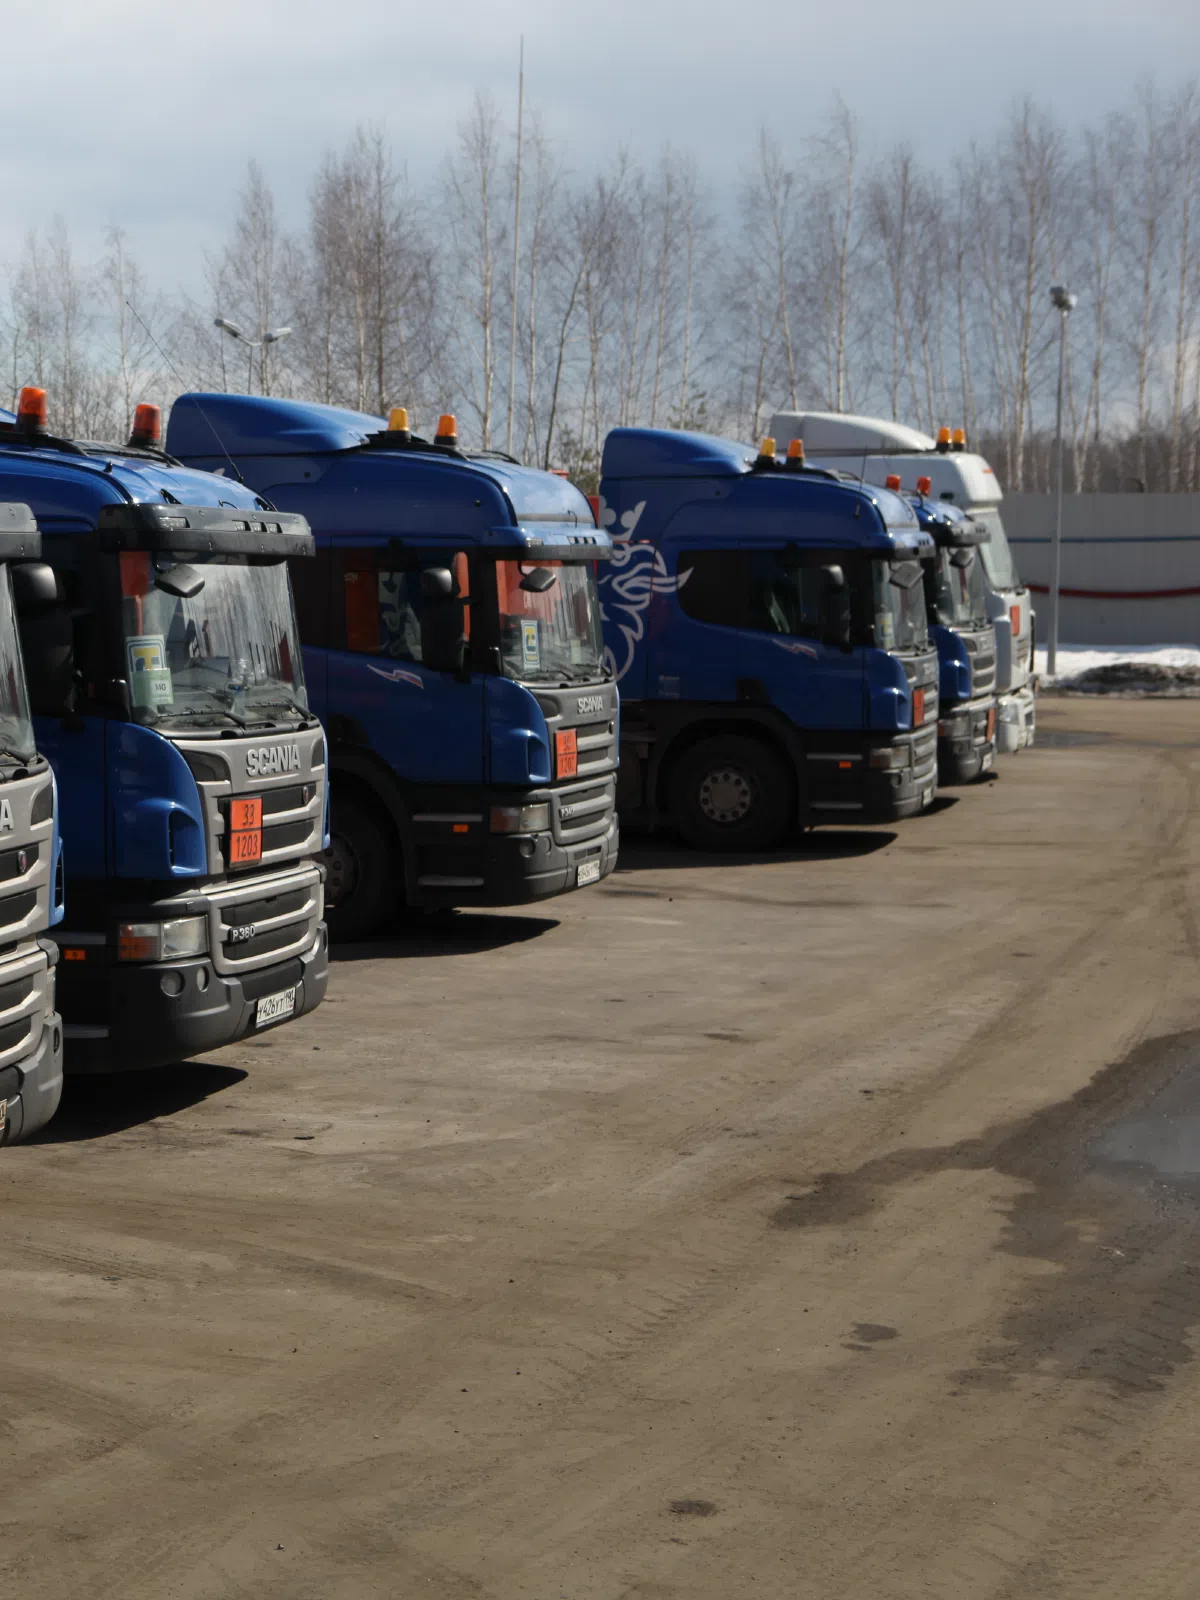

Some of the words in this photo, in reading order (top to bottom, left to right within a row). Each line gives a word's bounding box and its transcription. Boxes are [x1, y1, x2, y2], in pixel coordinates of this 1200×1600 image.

[577, 695, 604, 714] SCANIA
[246, 744, 301, 777] SCANIA
[242, 803, 255, 826] 33
[236, 834, 258, 857] 1203
